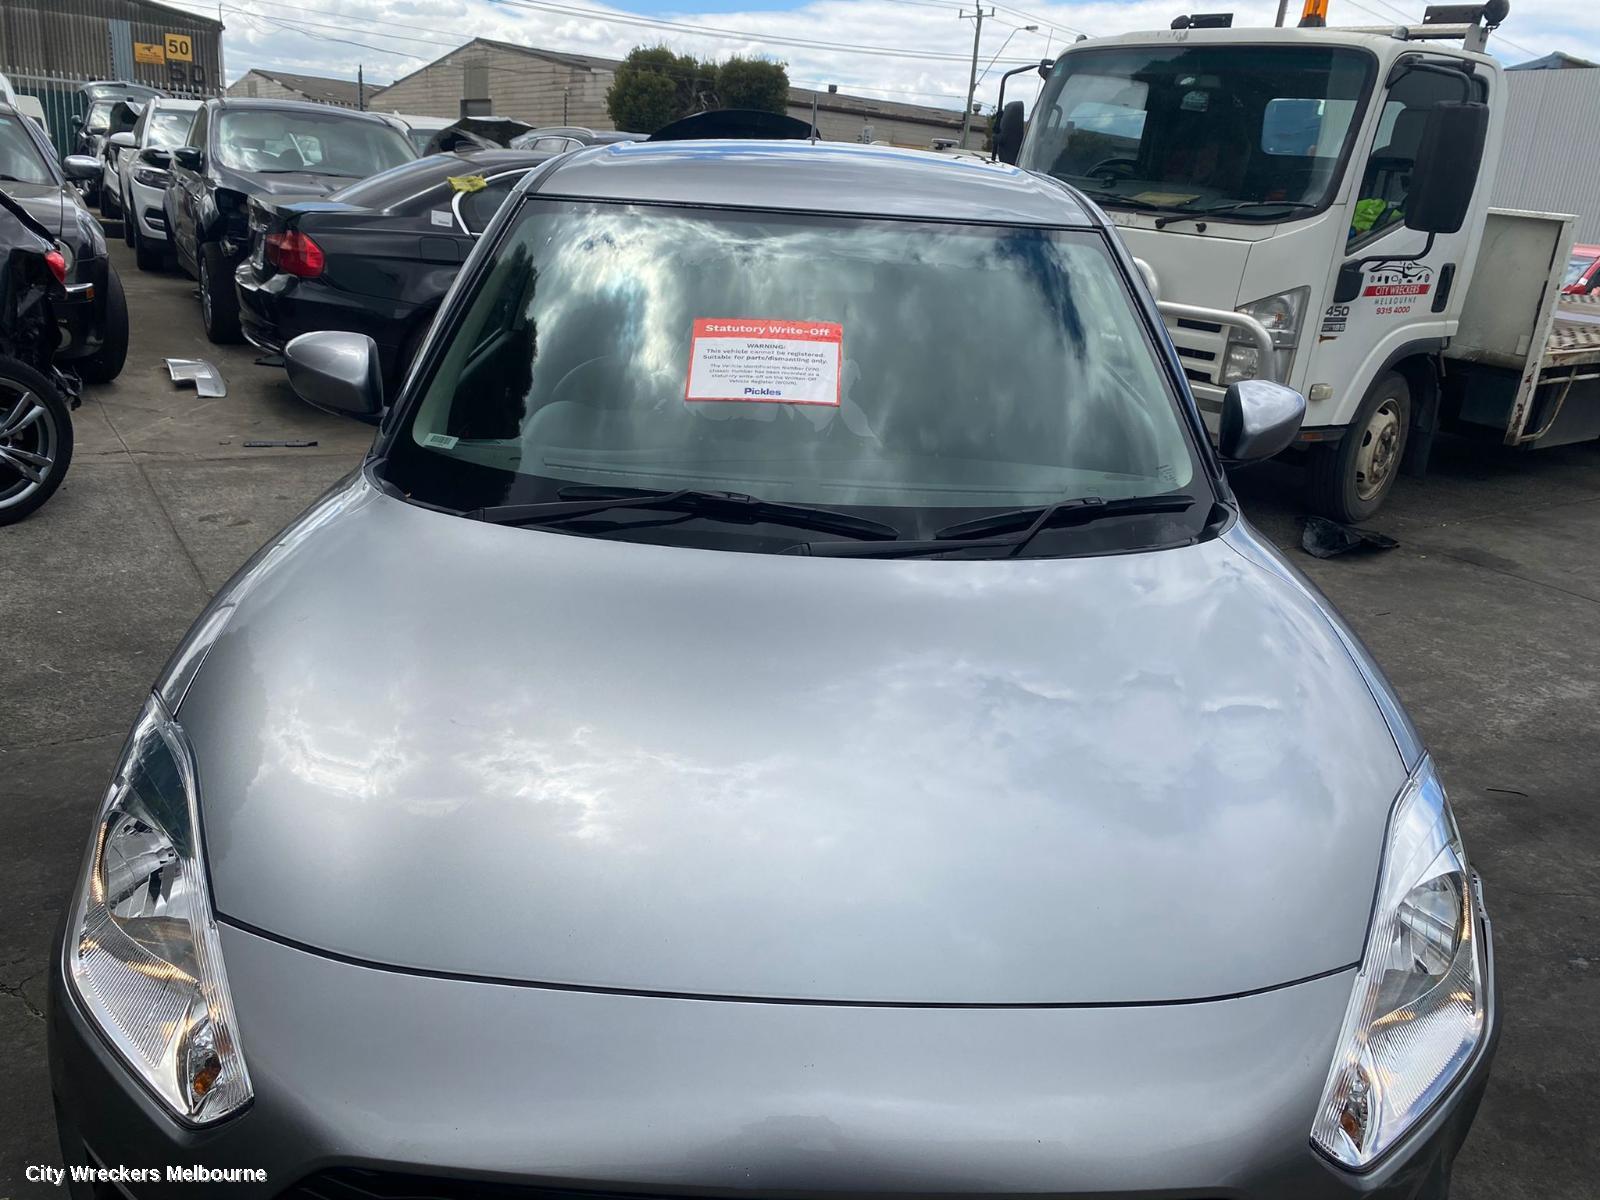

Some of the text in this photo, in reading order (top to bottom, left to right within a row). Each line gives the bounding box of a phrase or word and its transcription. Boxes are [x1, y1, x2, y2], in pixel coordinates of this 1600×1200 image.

[169, 40, 189, 55] 50
[1375, 285, 1420, 295] CITY WRECKERS
[1374, 296, 1417, 305] MELBOURNE
[1325, 305, 1350, 316] 450
[1376, 307, 1392, 315] 9315
[705, 324, 830, 336] Statutory Write-Off
[746, 355, 810, 364] parts/dismantling
[744, 387, 782, 396] Pickles
